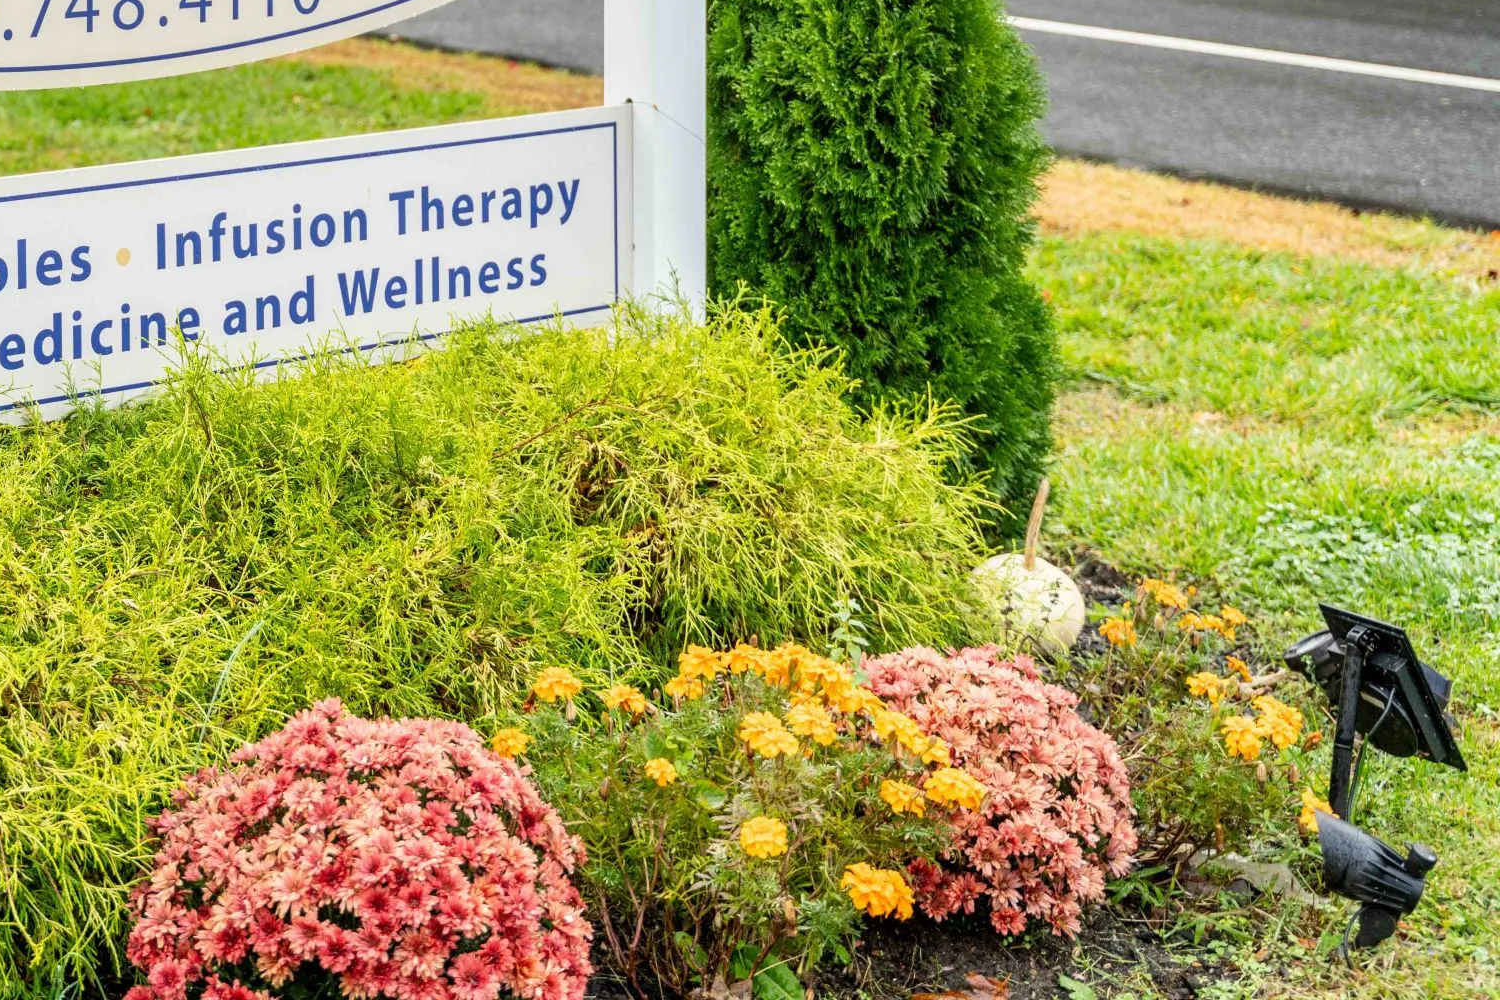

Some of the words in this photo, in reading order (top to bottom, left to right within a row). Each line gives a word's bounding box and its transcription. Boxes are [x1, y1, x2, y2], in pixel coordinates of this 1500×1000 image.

[155, 208, 369, 270] Infusion
[387, 179, 581, 236] Therapy
[222, 274, 316, 337] and
[336, 253, 548, 317] Wellness
